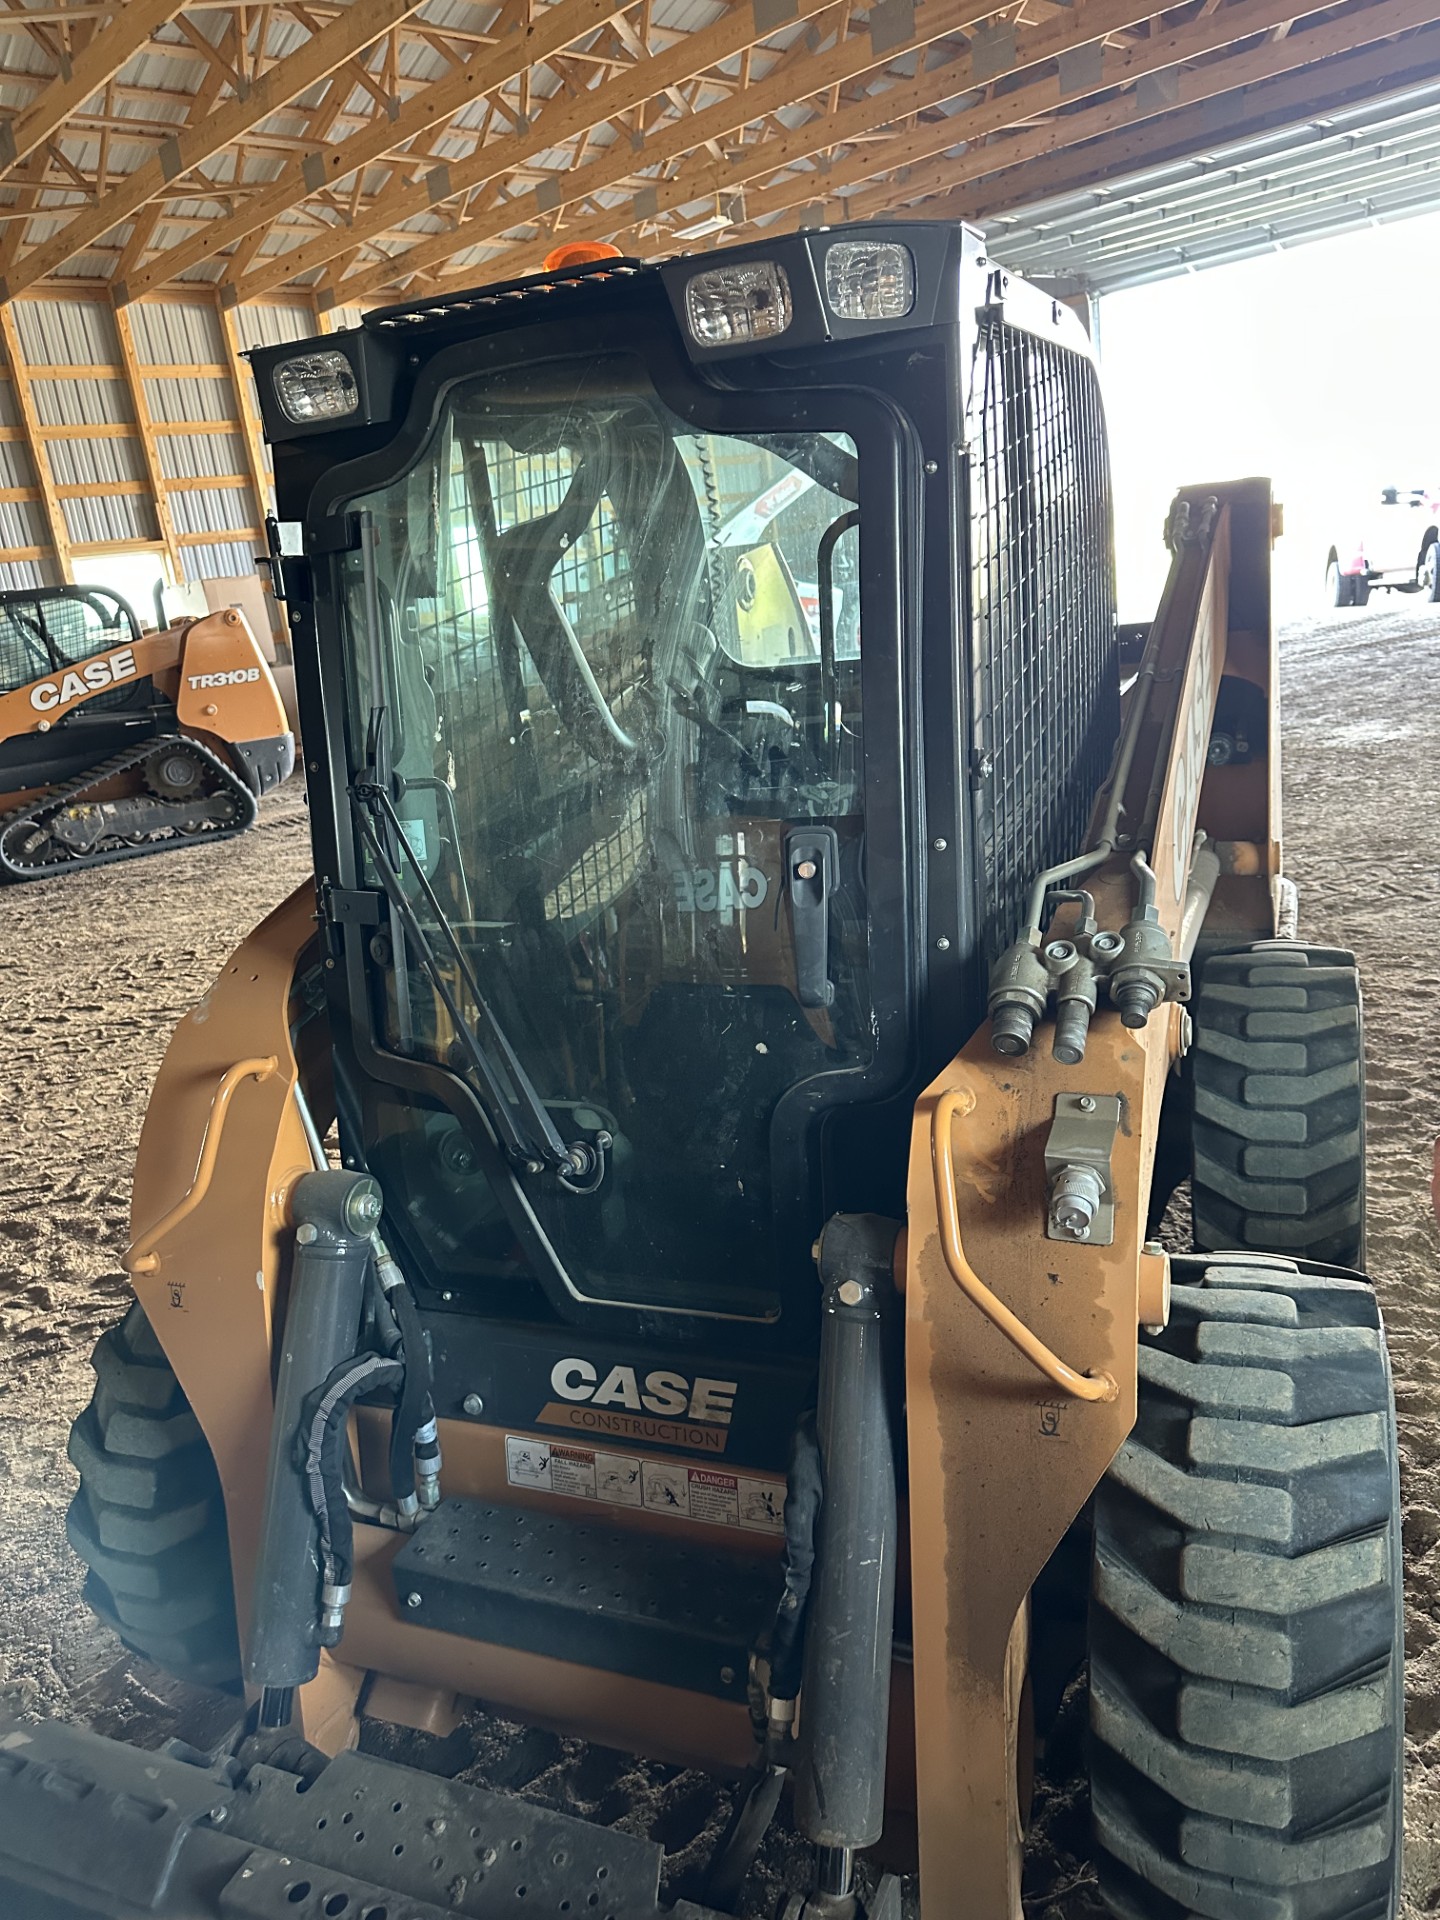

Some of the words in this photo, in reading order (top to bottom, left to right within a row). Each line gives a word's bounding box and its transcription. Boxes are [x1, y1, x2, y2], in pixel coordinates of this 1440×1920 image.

[30, 648, 138, 712] CASE
[187, 667, 261, 690] TR310B
[1172, 608, 1213, 904] CASE
[550, 1358, 738, 1424] CASE
[569, 1410, 720, 1448] CONSTRUCTION
[558, 1448, 593, 1462] WARNING
[569, 1461, 592, 1470] HAZARD
[690, 1483, 711, 1491] CRUSH
[712, 1486, 736, 1496] HAZARD
[700, 1473, 736, 1487] DANGER
